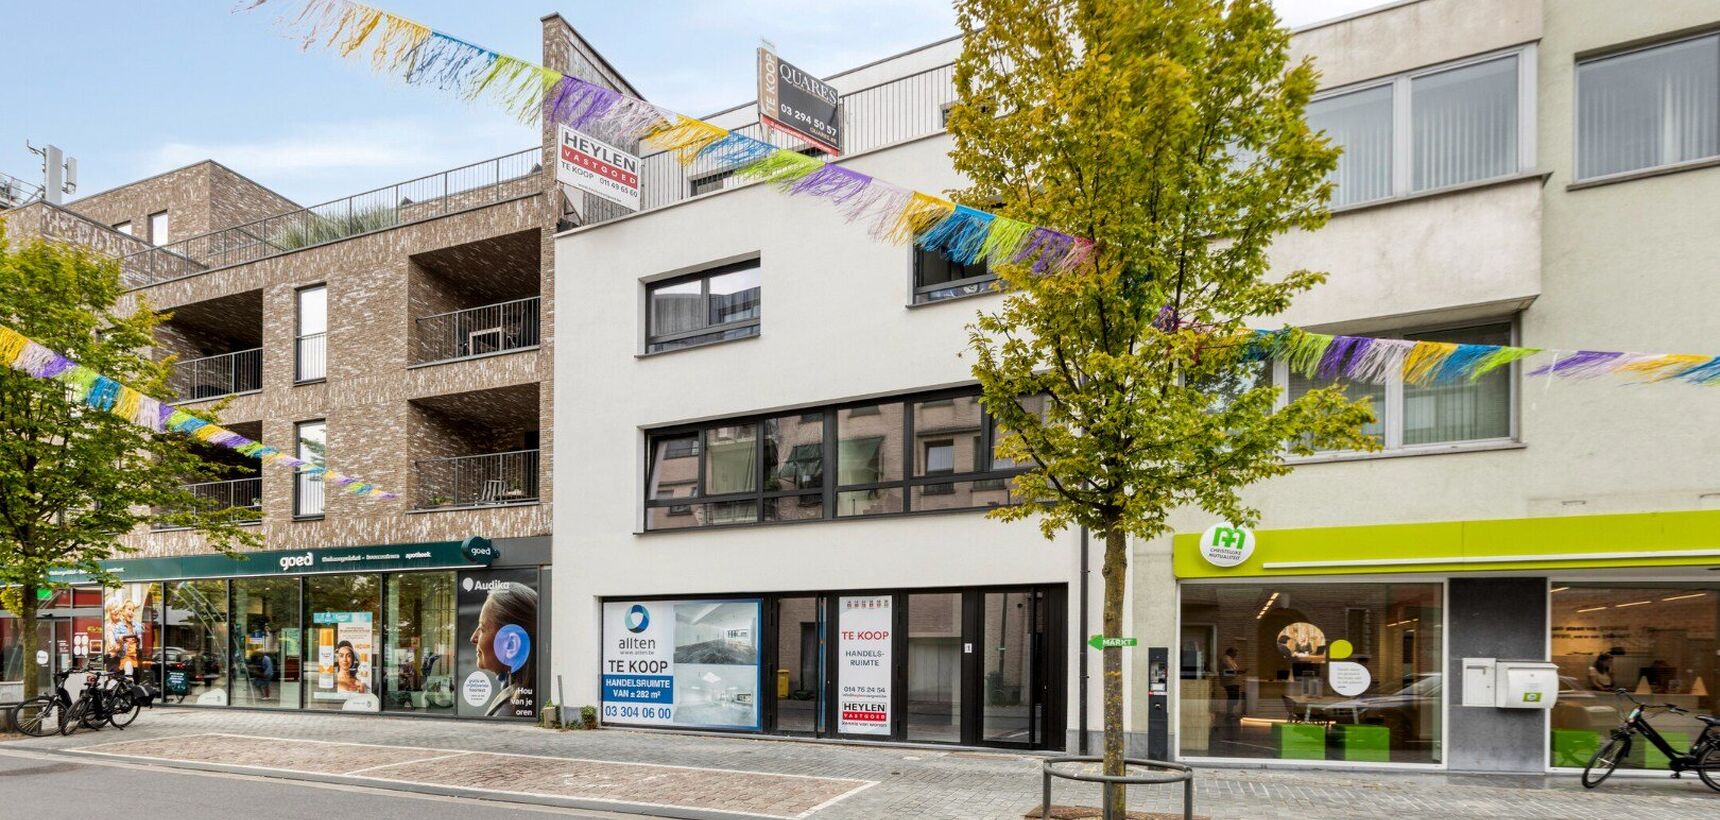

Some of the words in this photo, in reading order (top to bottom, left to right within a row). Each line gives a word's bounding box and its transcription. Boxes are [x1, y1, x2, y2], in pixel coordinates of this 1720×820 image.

[765, 53, 776, 94] KOOP
[779, 63, 838, 105] QUARES
[766, 97, 776, 112] TE
[781, 103, 793, 116] 03
[795, 110, 812, 125] 294
[813, 119, 825, 130] 50
[564, 131, 636, 174] HEYLEN
[561, 160, 570, 171] TE
[572, 165, 594, 179] KOOP
[564, 149, 636, 184] VASTGOED
[470, 547, 492, 556] goed
[279, 551, 314, 571] goed
[474, 580, 510, 591] Audika
[841, 631, 854, 640] TE
[857, 631, 889, 640] KOOP
[619, 638, 656, 649] allten
[1102, 638, 1132, 647] MARKT
[608, 660, 624, 673] TE
[629, 660, 668, 674] KOOP
[606, 679, 671, 688] HANDELSRUIMTE
[517, 687, 533, 695] Hou
[613, 689, 629, 698] VAN
[636, 690, 650, 699] 282
[525, 698, 533, 707] je
[843, 703, 885, 711] HEYLEN
[605, 706, 618, 717] 03
[620, 706, 640, 718] 304
[642, 707, 655, 719] 06
[658, 708, 671, 719] 00
